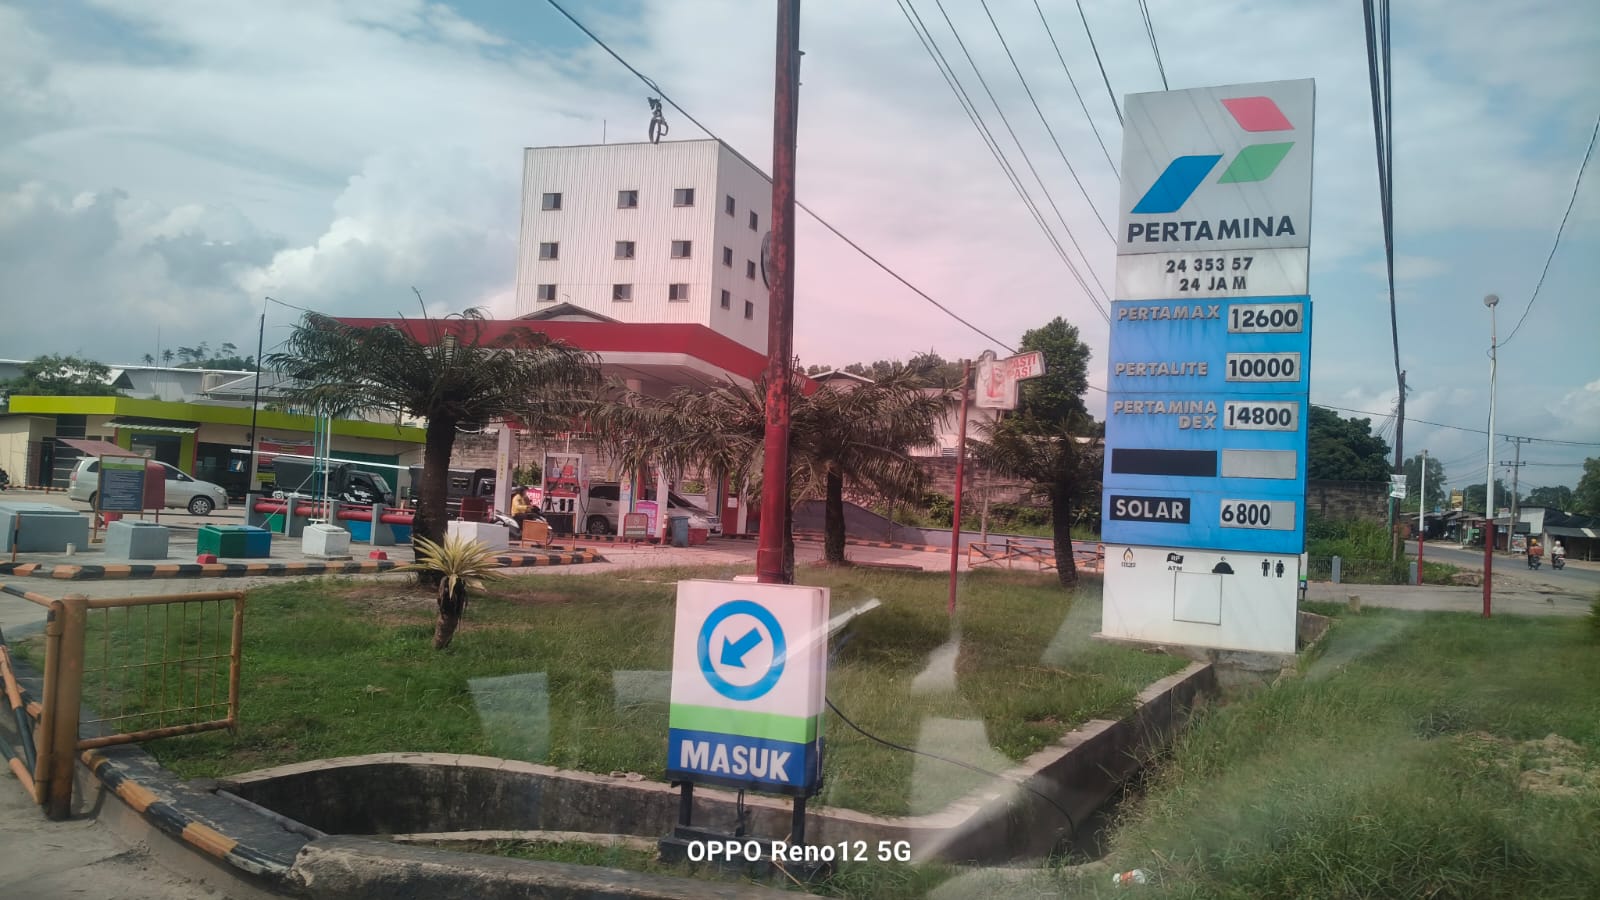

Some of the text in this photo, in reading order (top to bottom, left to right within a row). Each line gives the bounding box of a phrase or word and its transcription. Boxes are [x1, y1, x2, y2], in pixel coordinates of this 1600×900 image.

[1127, 215, 1296, 243] PERTAMINA
[1166, 257, 1253, 273] 24 353 57
[1179, 278, 1201, 291] 24
[1117, 304, 1299, 328] PERTAMAX 12600
[1114, 358, 1295, 378] PERTALITE 10000
[1113, 400, 1292, 427] PERTAMINA 14800
[1178, 415, 1217, 430] DEX
[1115, 499, 1271, 526] SOLAR 6800
[680, 739, 792, 782] MASUK
